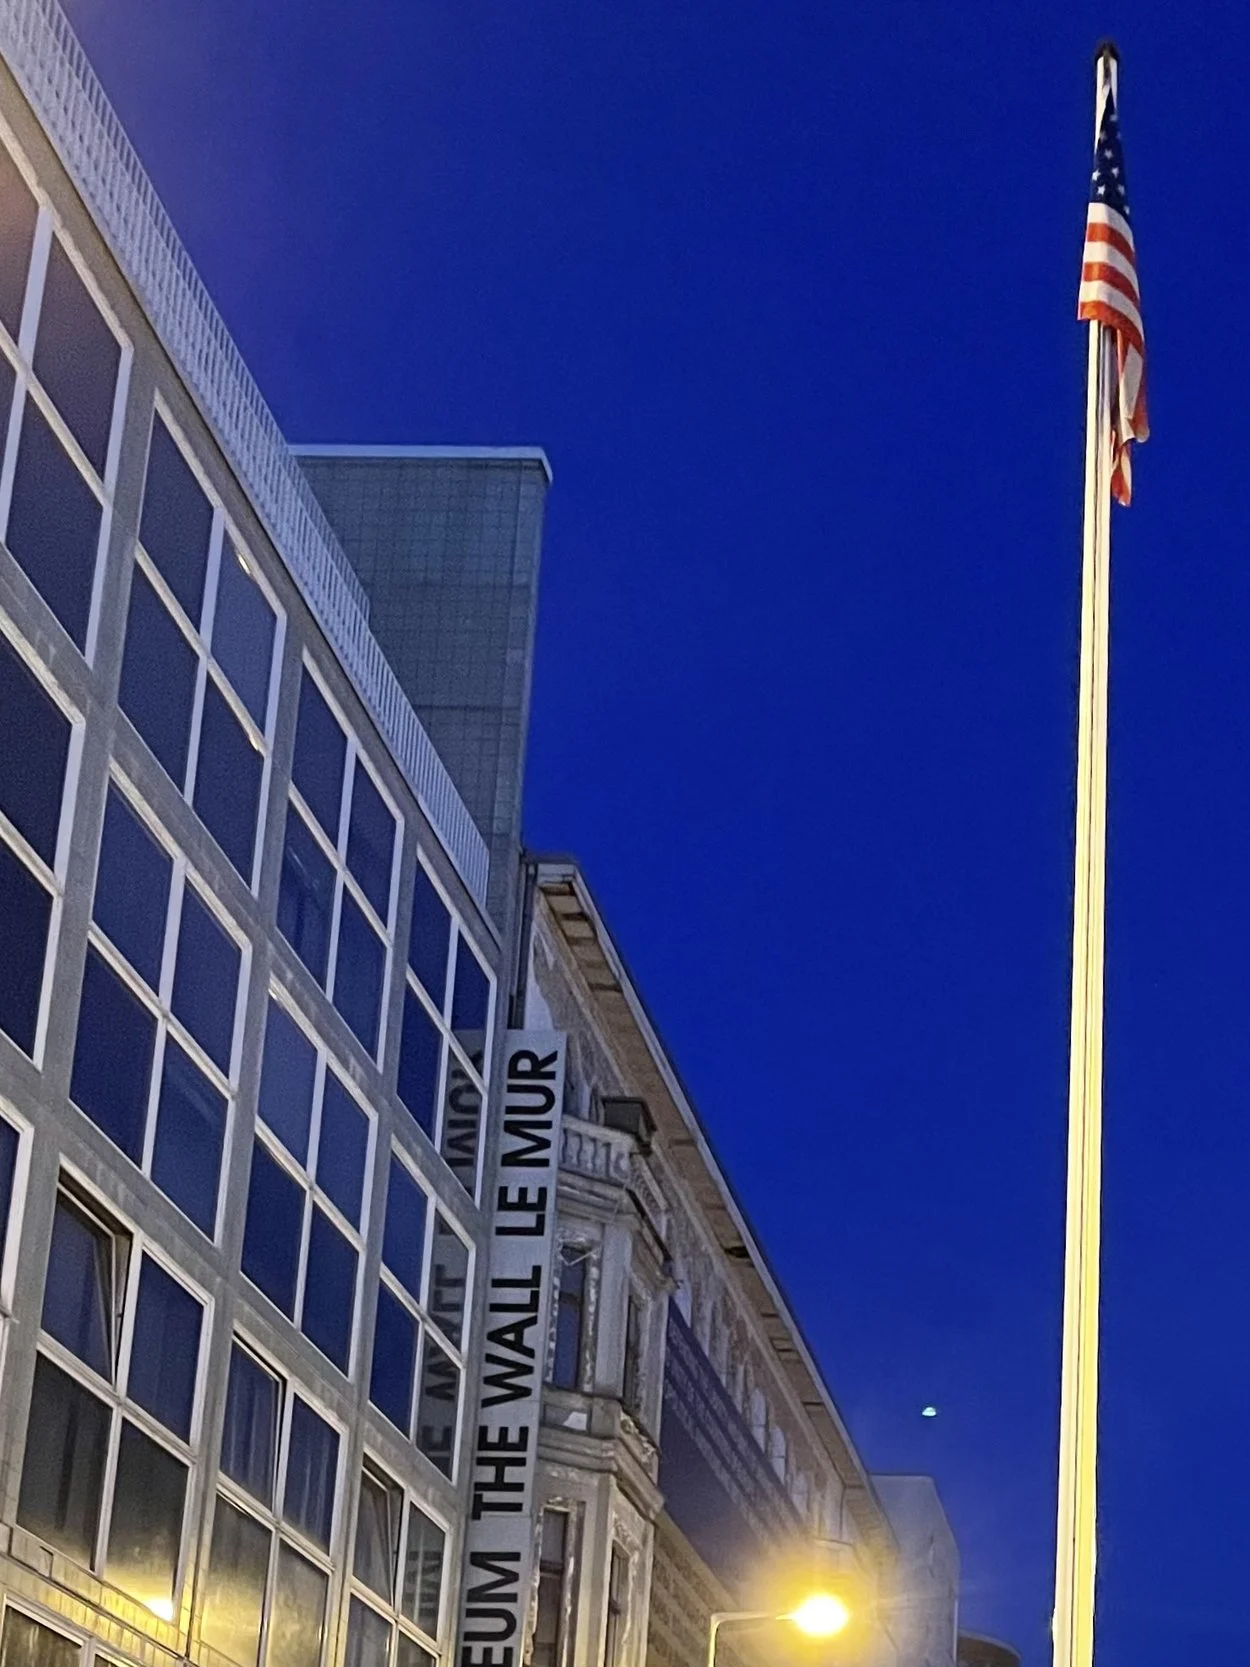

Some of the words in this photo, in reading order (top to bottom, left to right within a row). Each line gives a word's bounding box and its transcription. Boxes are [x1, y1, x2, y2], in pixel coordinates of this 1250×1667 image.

[501, 1050, 558, 1168] MUR
[494, 1185, 548, 1236] LE
[481, 1265, 543, 1409] WALL
[471, 1426, 529, 1521] THE
